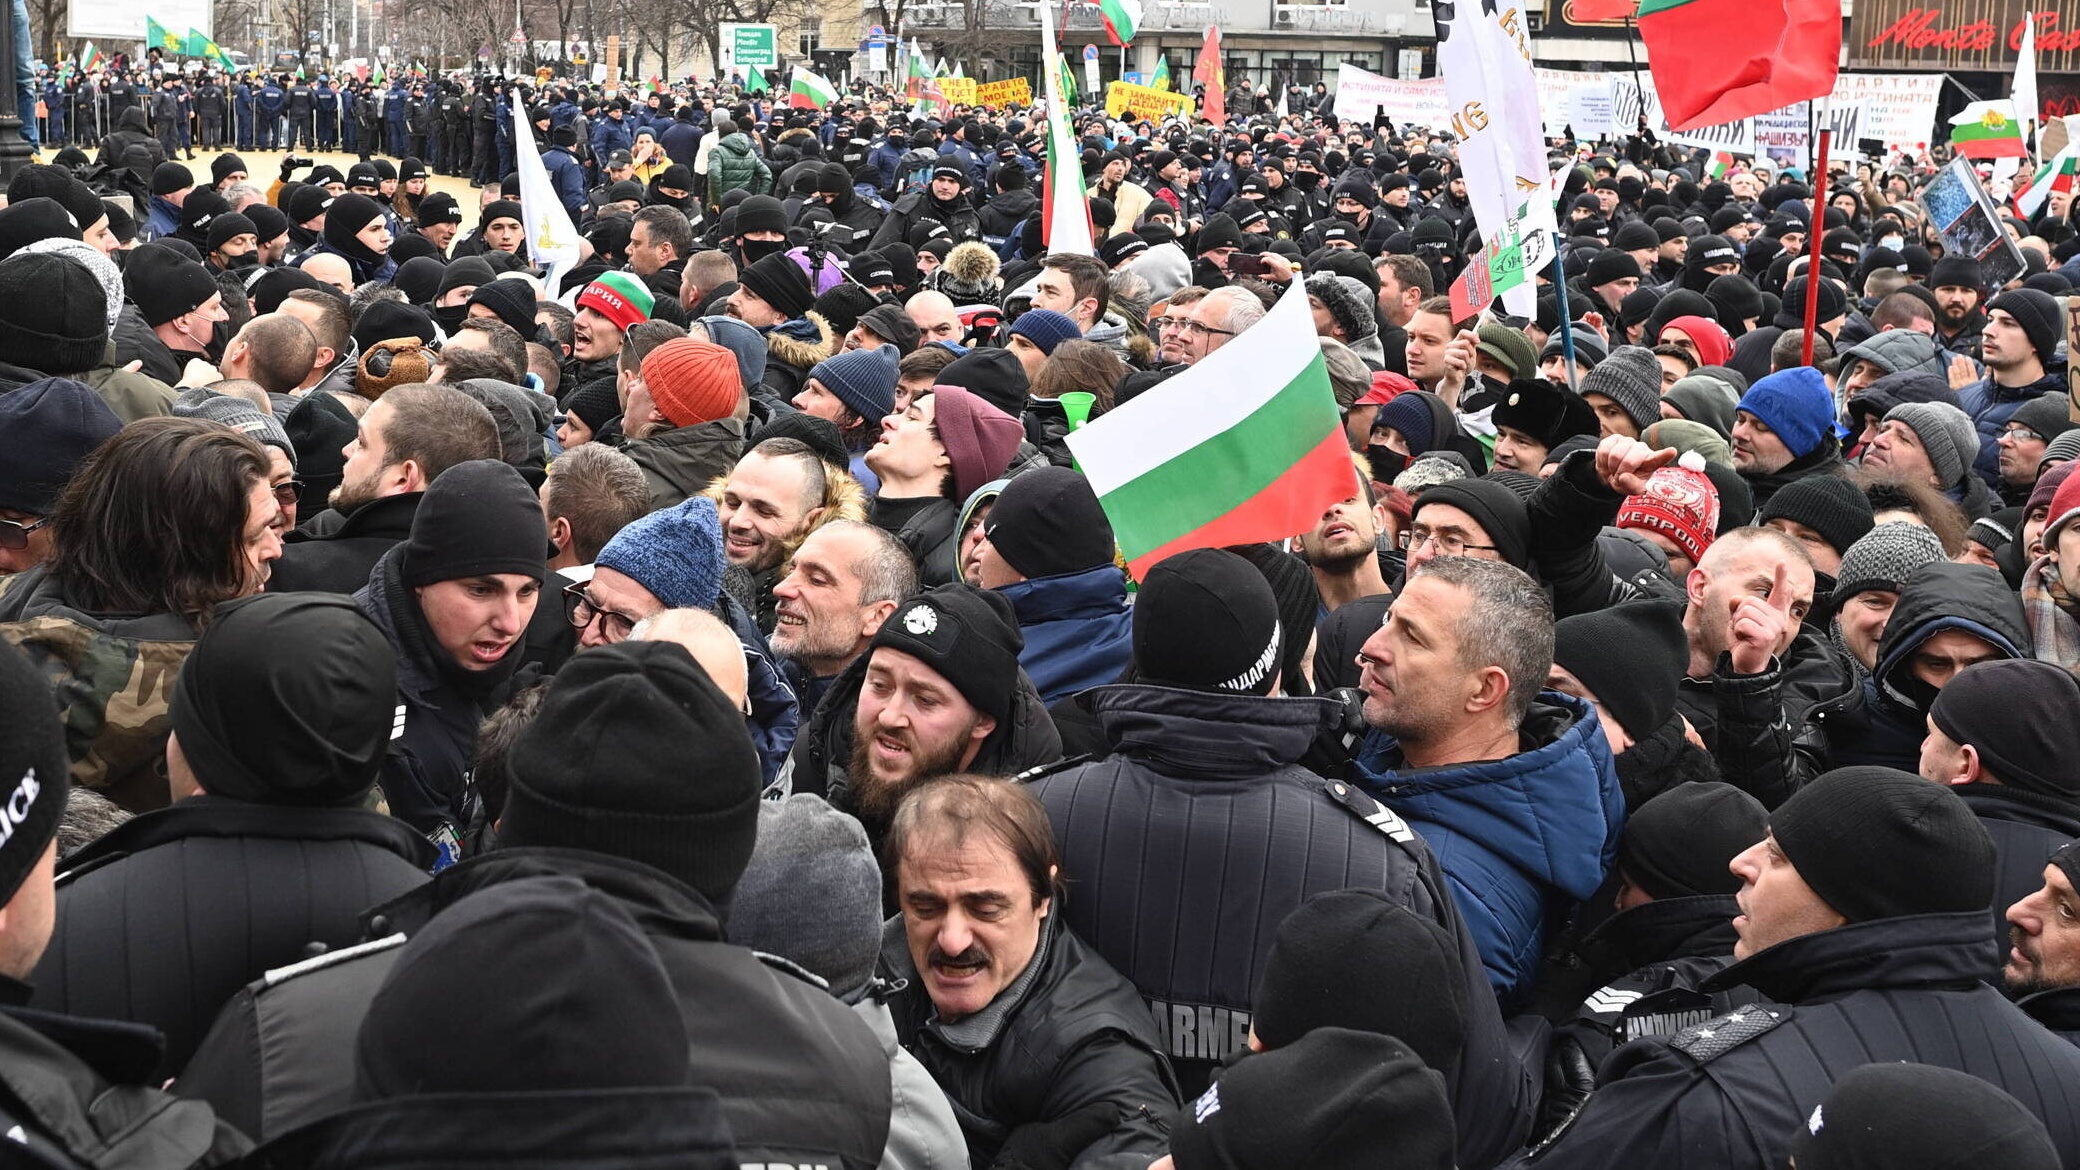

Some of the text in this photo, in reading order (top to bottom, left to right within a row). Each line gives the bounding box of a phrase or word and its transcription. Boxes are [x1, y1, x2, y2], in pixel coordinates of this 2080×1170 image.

[1867, 8, 1996, 50] Monte
[1839, 76, 1934, 89] ПАРТИЯ
[1619, 510, 1702, 558] VERPOOL
